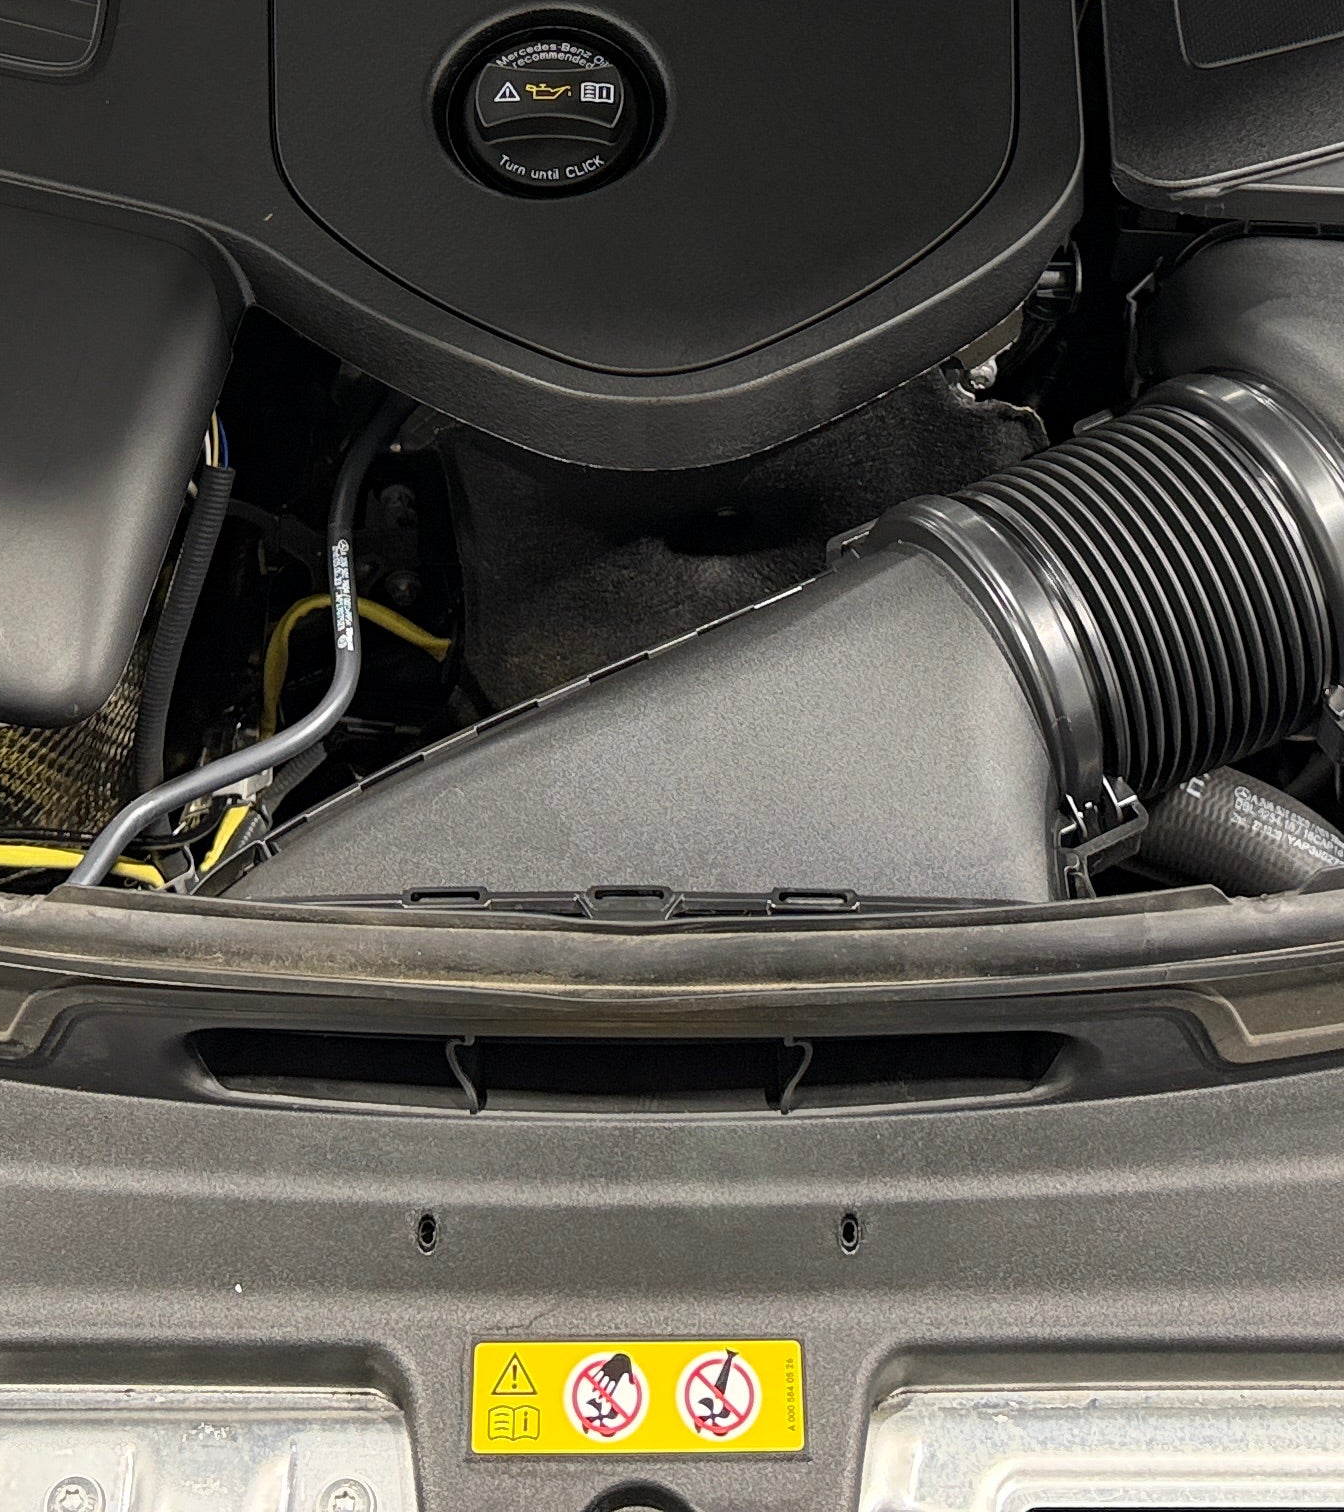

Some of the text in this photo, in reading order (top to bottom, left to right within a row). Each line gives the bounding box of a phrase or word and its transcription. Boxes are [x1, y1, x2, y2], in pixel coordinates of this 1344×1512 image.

[496, 43, 593, 67] Mercedes-Benz
[512, 51, 596, 69] recommended
[499, 154, 605, 180] Turn until CLICK
[787, 1405, 796, 1423] 000
